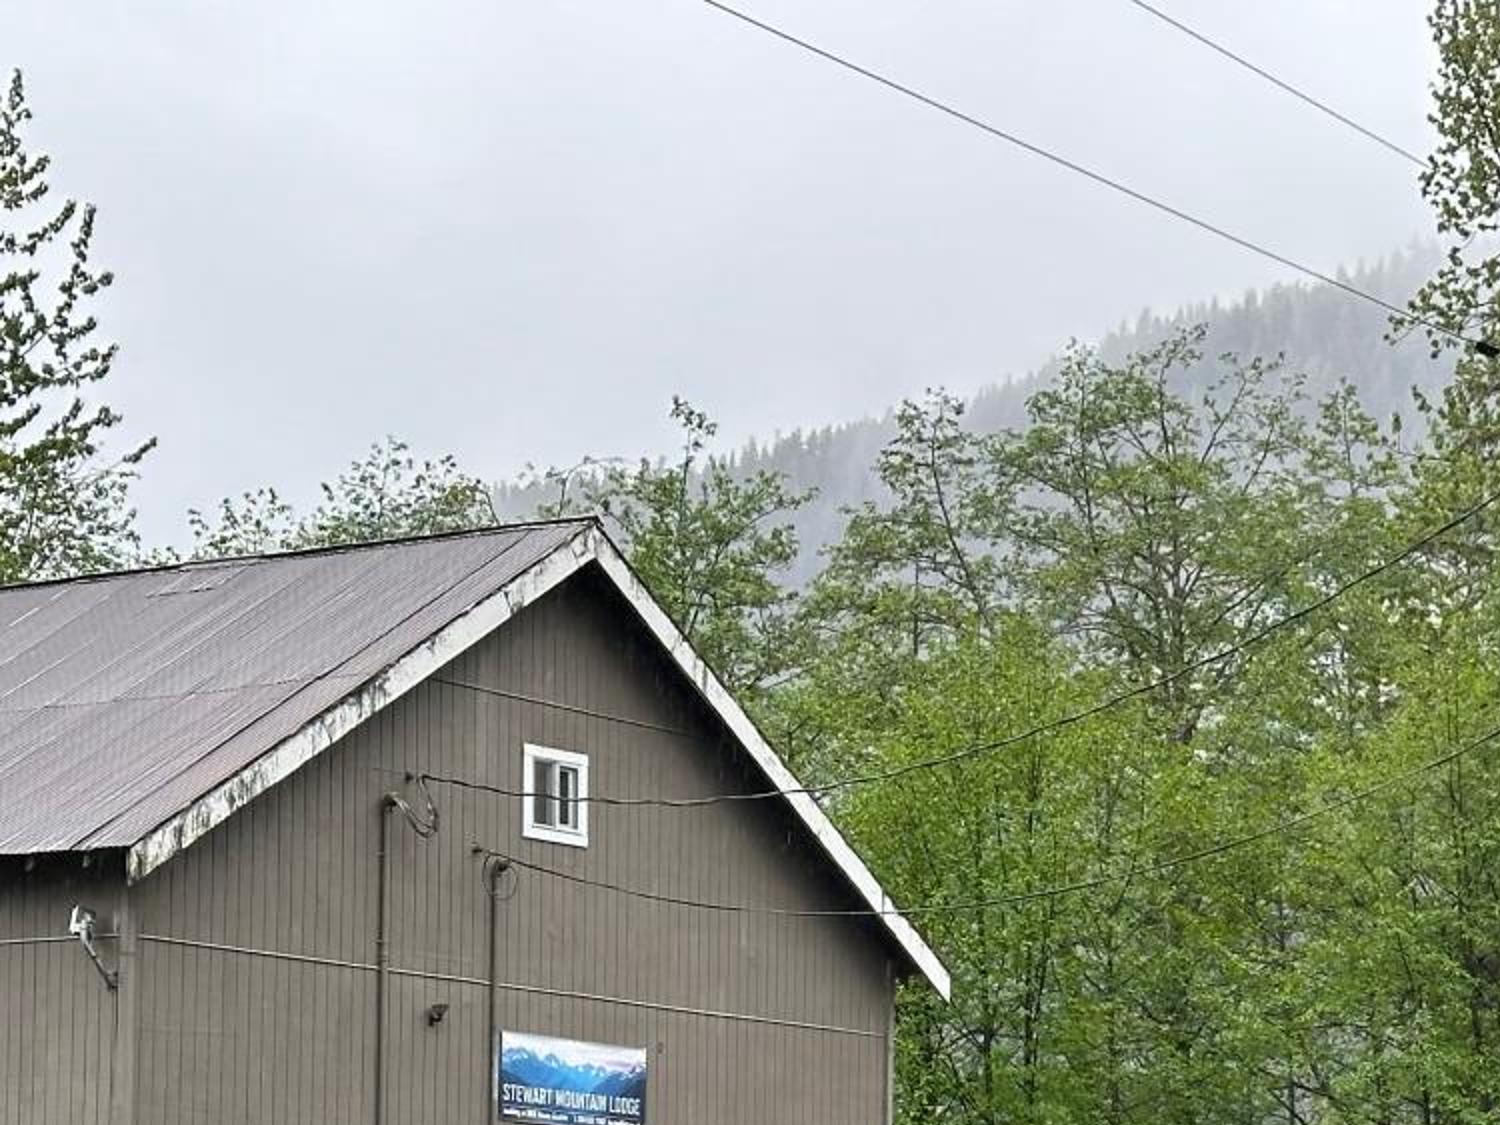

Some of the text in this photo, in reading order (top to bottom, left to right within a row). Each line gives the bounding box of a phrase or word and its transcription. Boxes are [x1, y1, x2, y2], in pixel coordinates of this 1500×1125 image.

[503, 1083, 640, 1115] STEWART MOUNTAIN LODGE
